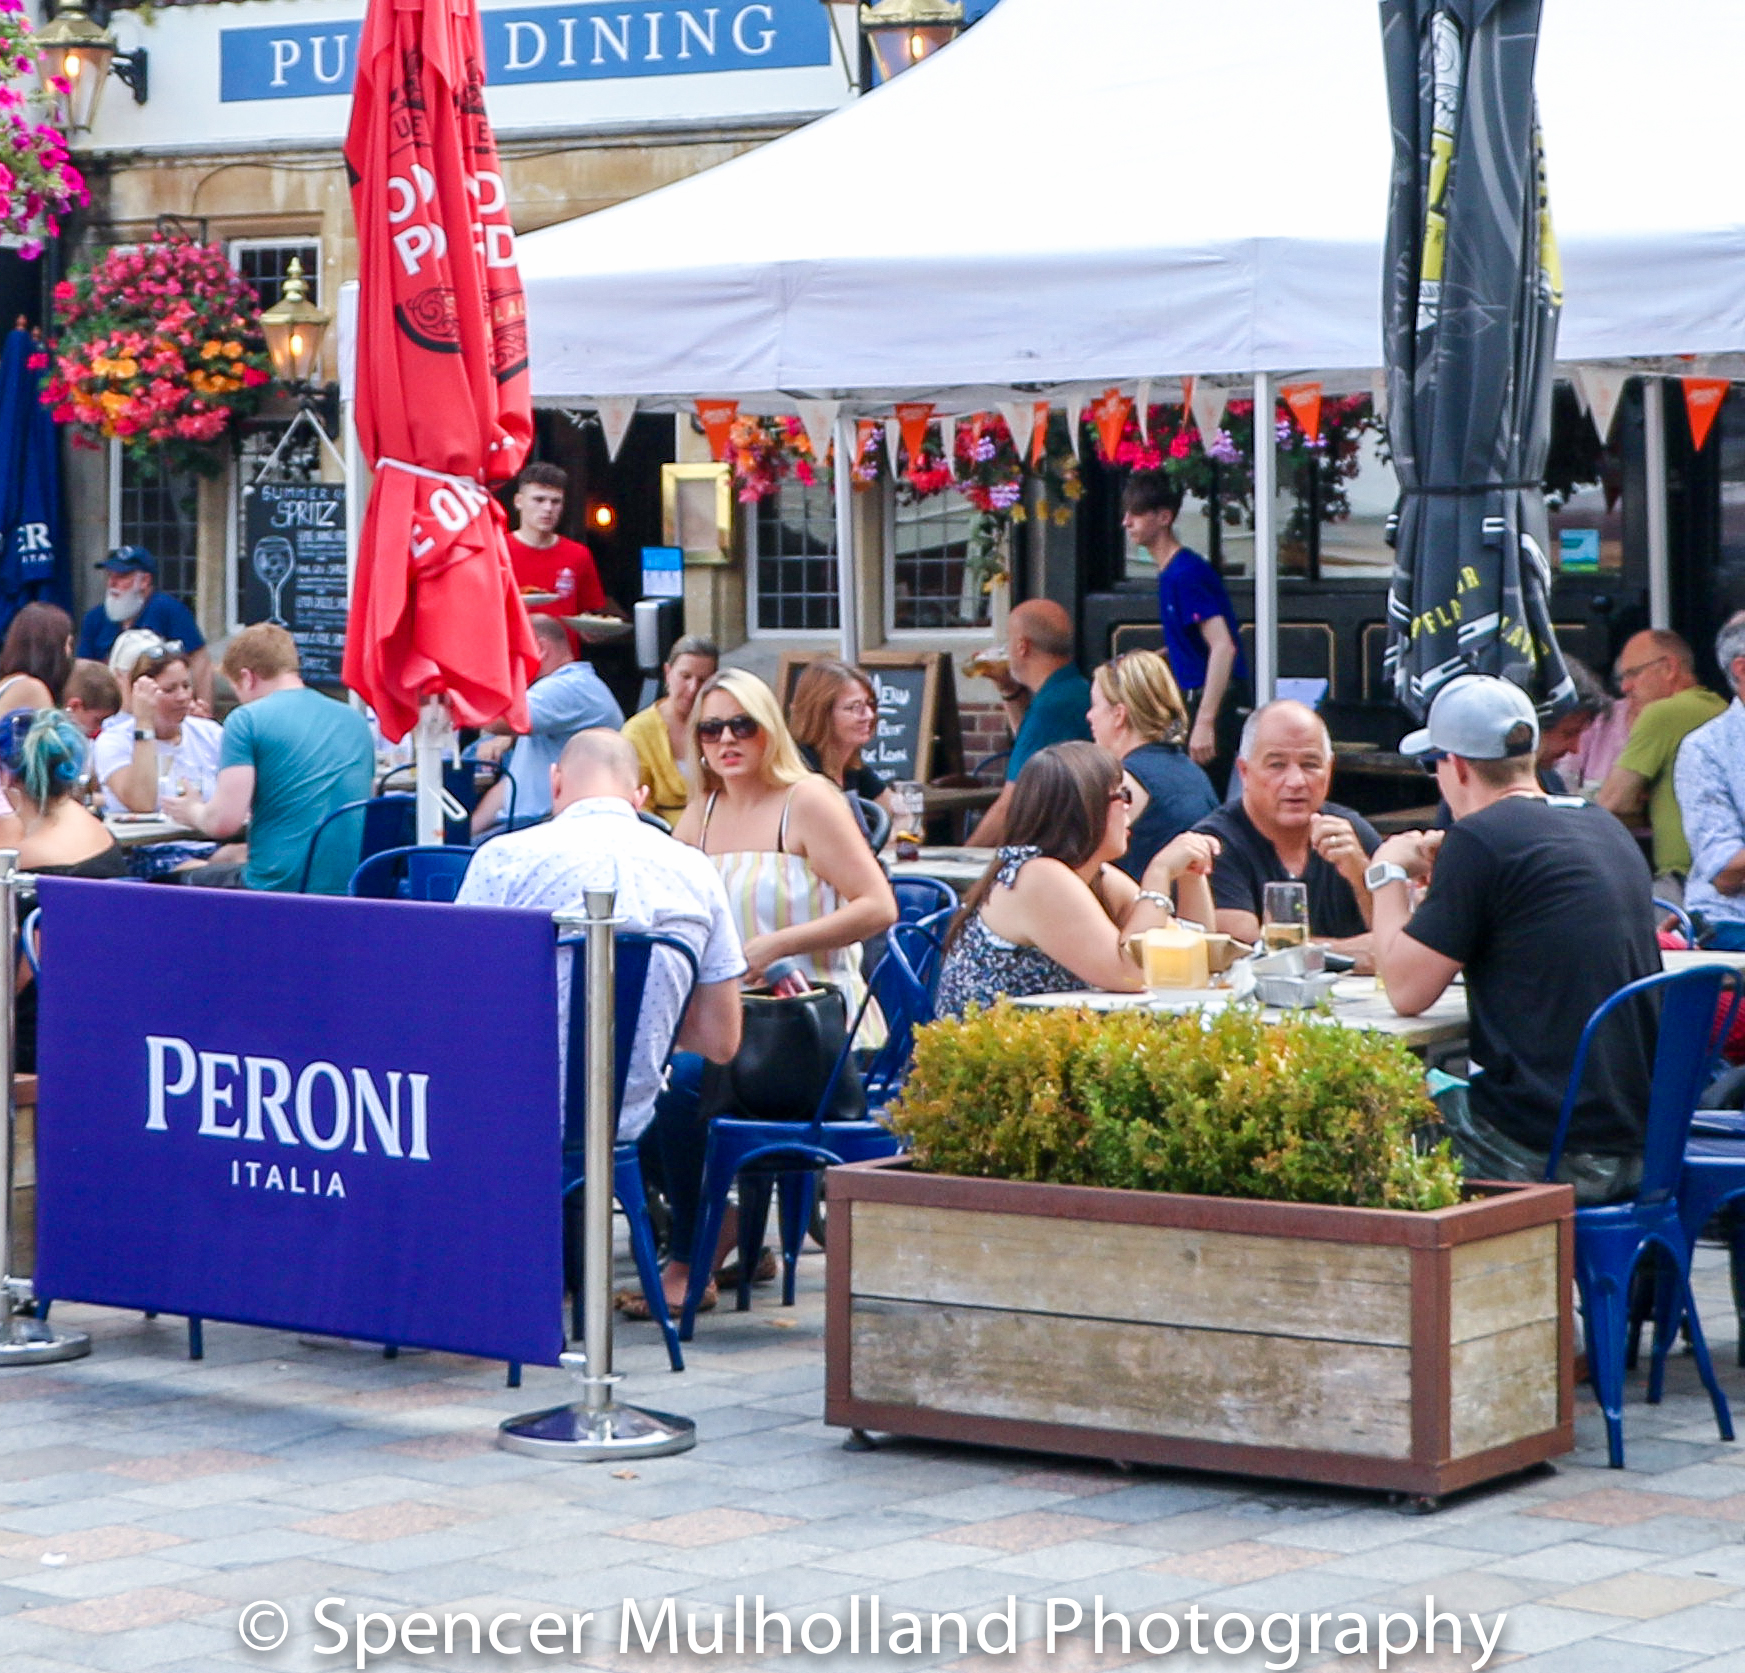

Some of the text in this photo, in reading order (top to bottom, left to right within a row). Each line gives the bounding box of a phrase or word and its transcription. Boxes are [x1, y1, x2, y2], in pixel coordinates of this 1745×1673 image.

[269, 4, 778, 88] PU DINING
[270, 500, 339, 528] SPRITZ
[145, 1034, 432, 1161] PERONI
[231, 1159, 347, 1199] ITALIA
